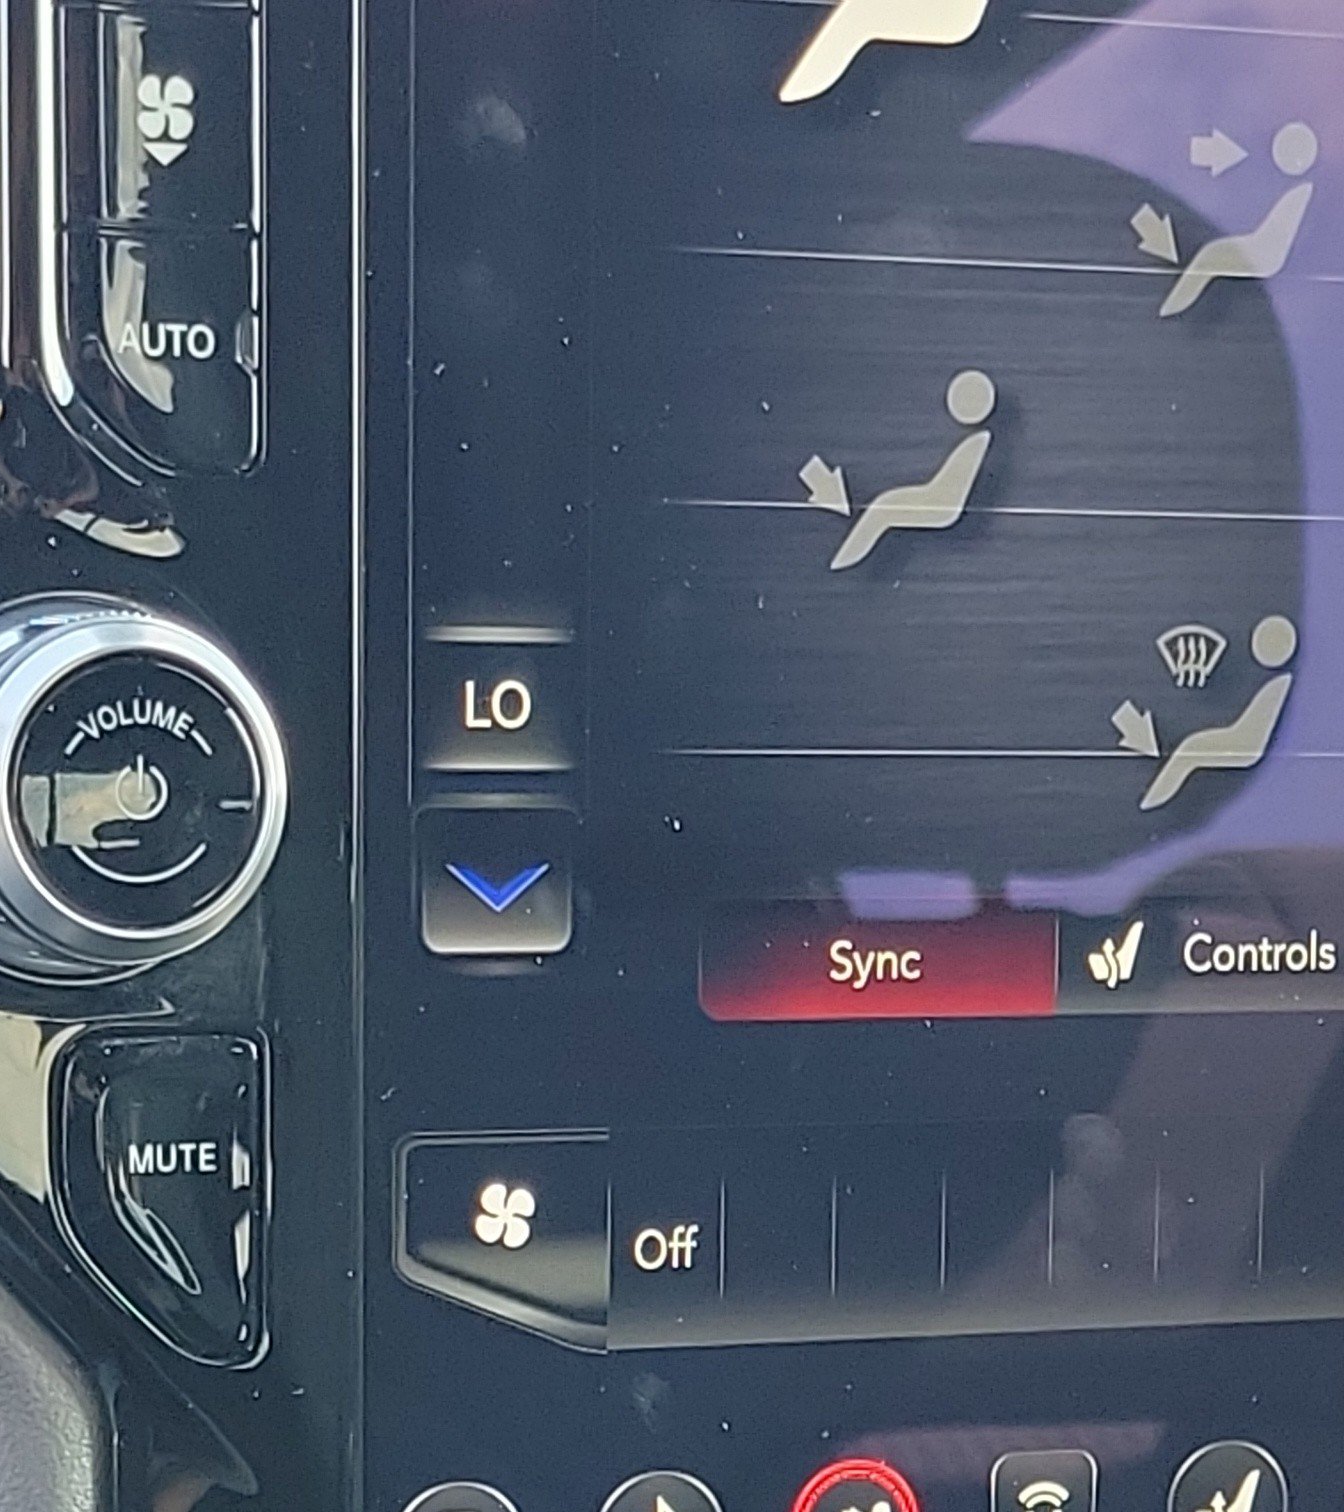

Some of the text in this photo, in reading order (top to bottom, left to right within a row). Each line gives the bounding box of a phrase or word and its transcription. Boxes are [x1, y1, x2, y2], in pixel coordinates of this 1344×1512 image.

[118, 323, 216, 360] AUTO
[80, 700, 194, 741] VOLUME
[464, 680, 532, 731] LO
[828, 939, 923, 988] Sync
[1182, 929, 1337, 975] Controls
[128, 1141, 218, 1175] MUTE
[632, 1224, 699, 1272] Off
